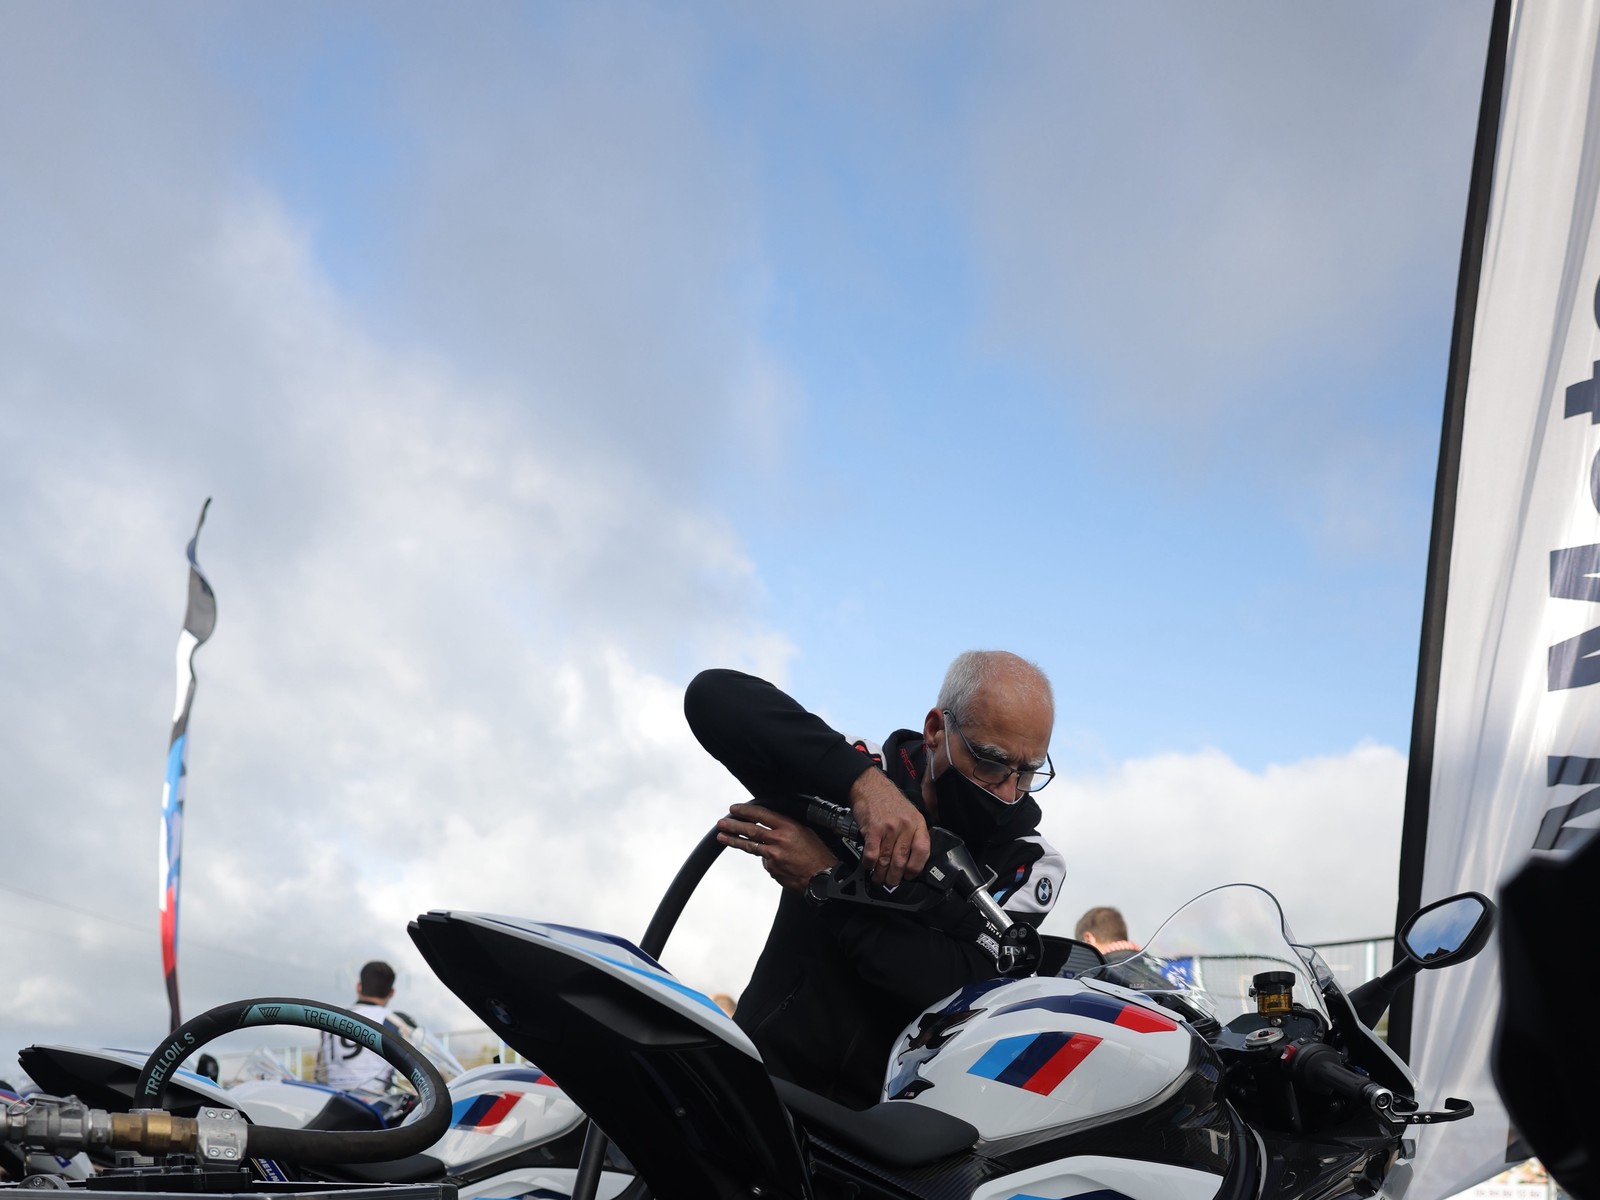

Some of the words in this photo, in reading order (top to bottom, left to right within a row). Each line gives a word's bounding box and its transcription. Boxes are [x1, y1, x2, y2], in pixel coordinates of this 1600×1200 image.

[304, 1008, 377, 1046] TRELLEBORG
[145, 1041, 186, 1096] TRELLOIL
[183, 1032, 196, 1046] S
